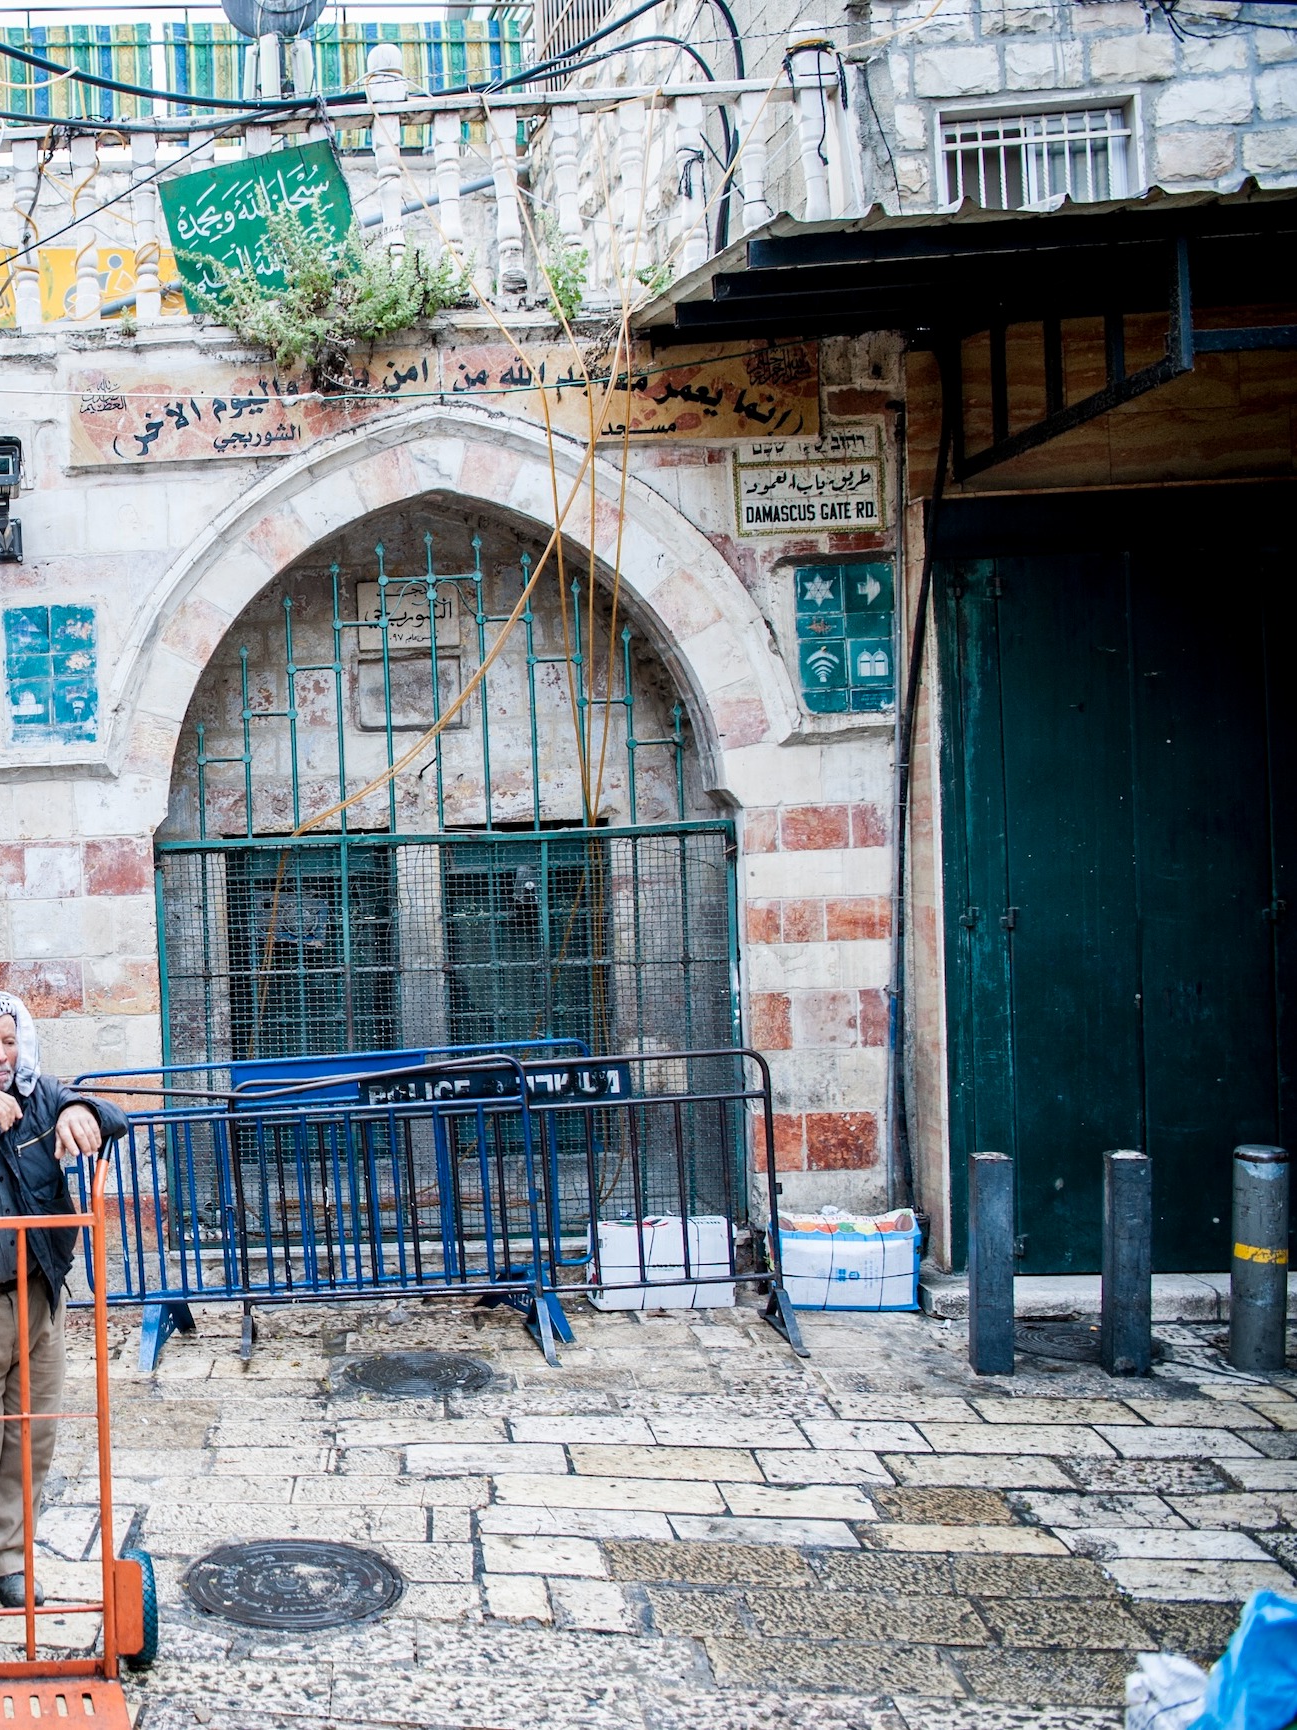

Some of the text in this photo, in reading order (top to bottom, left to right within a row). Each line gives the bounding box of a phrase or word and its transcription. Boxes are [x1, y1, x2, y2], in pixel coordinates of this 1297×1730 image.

[453, 362, 490, 393] من
[499, 355, 546, 388] الله
[213, 423, 302, 453] الشوربجي
[600, 421, 677, 439] مسجد
[796, 474, 827, 495] باب
[746, 501, 878, 524] DAMASCUS GATE RD.
[368, 1079, 472, 1106] POLICE
